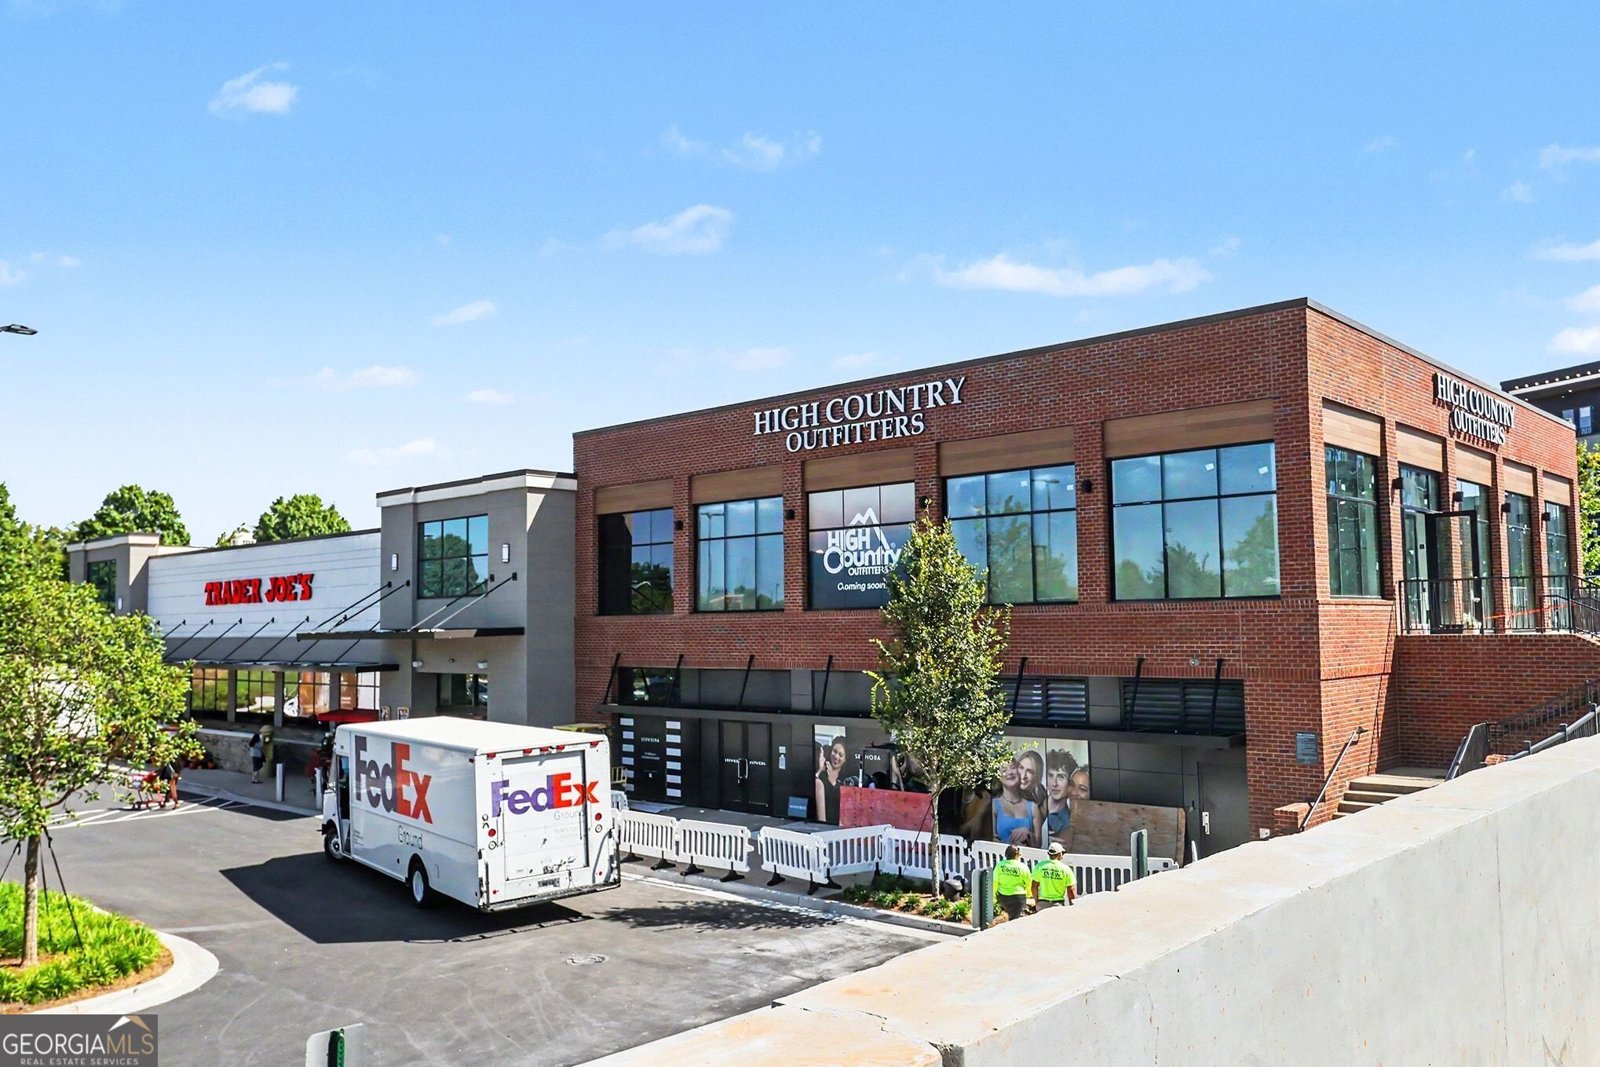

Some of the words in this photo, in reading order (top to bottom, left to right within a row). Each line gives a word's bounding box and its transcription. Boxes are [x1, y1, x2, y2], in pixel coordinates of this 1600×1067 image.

[753, 402, 820, 435] HIGH
[825, 376, 966, 424] COUNTRY
[1436, 372, 1468, 410] HIGH
[1469, 388, 1515, 428] COUNTRY
[785, 412, 926, 452] OUTFITTERS
[1453, 408, 1505, 445] OUTFITTERS
[827, 527, 871, 551] HIGH
[823, 546, 902, 574] Country
[204, 578, 262, 606] TRADER
[265, 573, 314, 603] JOE'S
[837, 582, 866, 592] Coming
[354, 734, 433, 825] FedEx
[491, 772, 600, 818] FedEx
[397, 824, 424, 850] Ground
